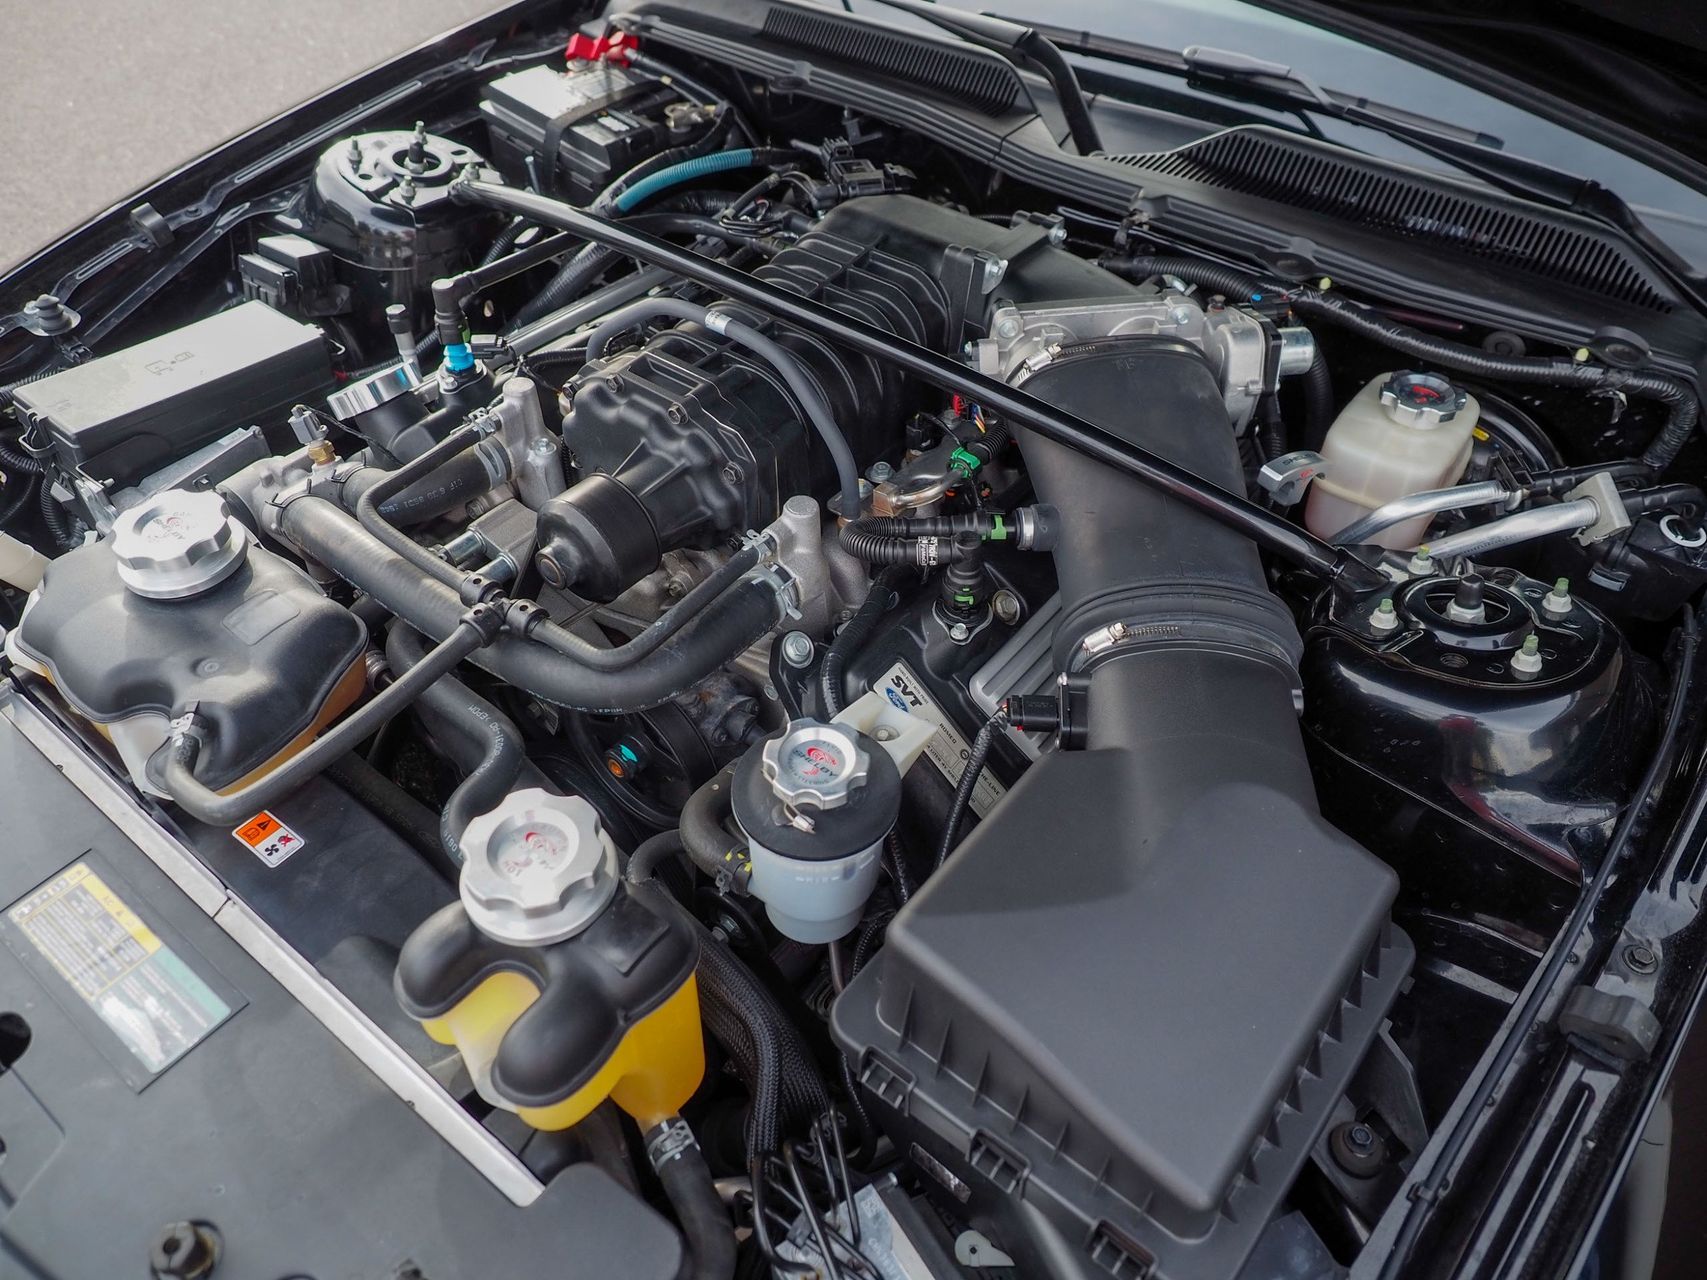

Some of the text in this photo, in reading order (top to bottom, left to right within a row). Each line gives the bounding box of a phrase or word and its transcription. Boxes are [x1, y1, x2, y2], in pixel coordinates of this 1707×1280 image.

[891, 675, 922, 708] SVT
[793, 749, 839, 777] SHELBY
[980, 772, 1001, 797] HE-LINE
